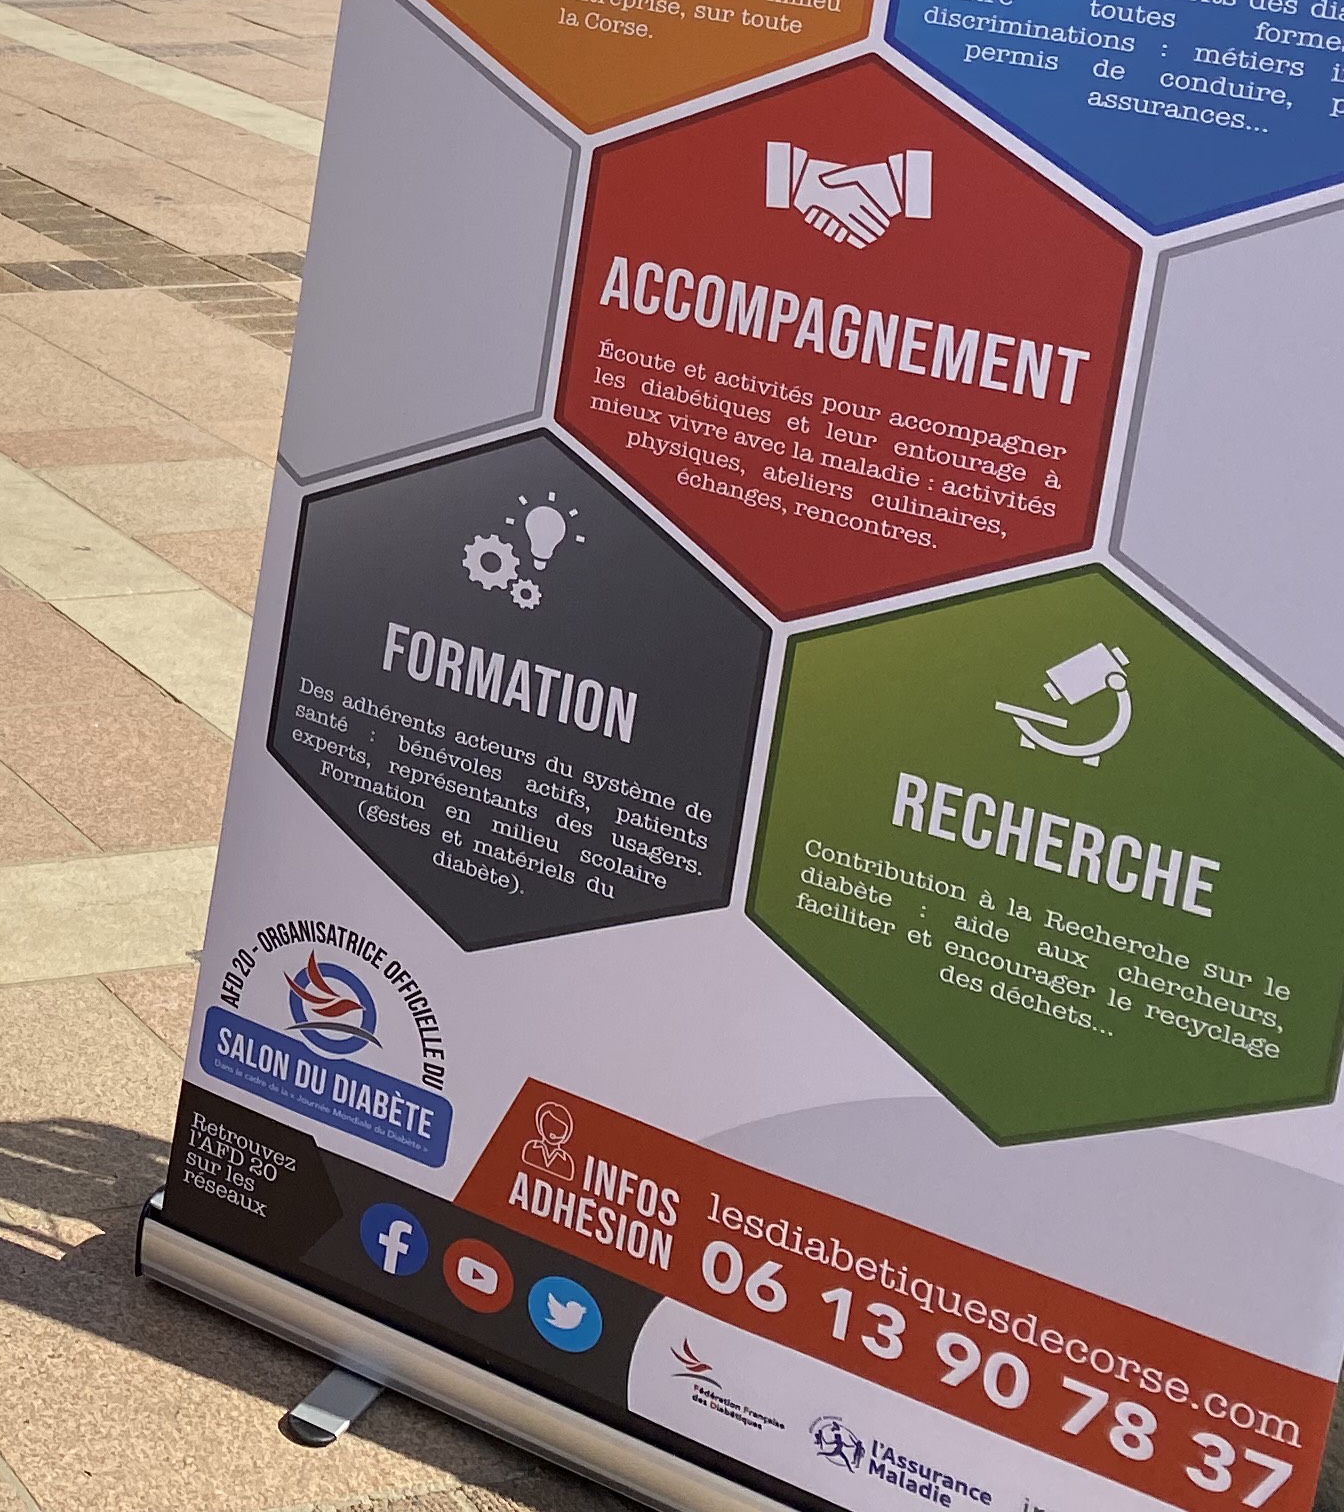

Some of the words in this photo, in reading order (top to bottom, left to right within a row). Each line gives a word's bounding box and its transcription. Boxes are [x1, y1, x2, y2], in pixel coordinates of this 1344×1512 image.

[558, 7, 579, 27] la
[585, 12, 653, 38] Corse.
[694, 5, 735, 23] sur
[742, 8, 803, 33] toute
[600, 256, 1090, 404] ACCOMPAGNEMENT
[383, 622, 637, 743] FORMATION
[892, 772, 1220, 917] RECHERCHE
[220, 975, 244, 1008] AFD
[232, 949, 256, 978] 20
[257, 920, 387, 969] ORGANISATRICE
[383, 960, 446, 1061] OFFICIELLE
[422, 1062, 446, 1090] DU
[217, 1027, 289, 1082] SALON
[295, 1057, 326, 1095] DU
[332, 1075, 434, 1139] DIABÈTE
[186, 1152, 221, 1176] sur
[225, 1164, 255, 1191] les
[188, 1129, 244, 1166] l'AFD
[249, 1157, 277, 1181] 20
[191, 1111, 296, 1171] Retrouvez
[183, 1169, 267, 1217] réseaux
[508, 1171, 673, 1271] ADHÉSION
[583, 1155, 679, 1226] INFOS
[707, 1192, 1302, 1448] lesdiabetiquesdecorse.com
[694, 1384, 741, 1411] Fédération
[743, 1406, 785, 1429] Française
[702, 1241, 787, 1312] 06
[821, 1287, 906, 1359] 13
[936, 1332, 1029, 1409] 90
[1061, 1376, 1157, 1460] 78
[1185, 1432, 1293, 1508] 37
[692, 1394, 707, 1406] des
[710, 1401, 762, 1430] Diabétiques
[869, 1458, 951, 1508] Maladie
[872, 1439, 992, 1506] l'Assurance
